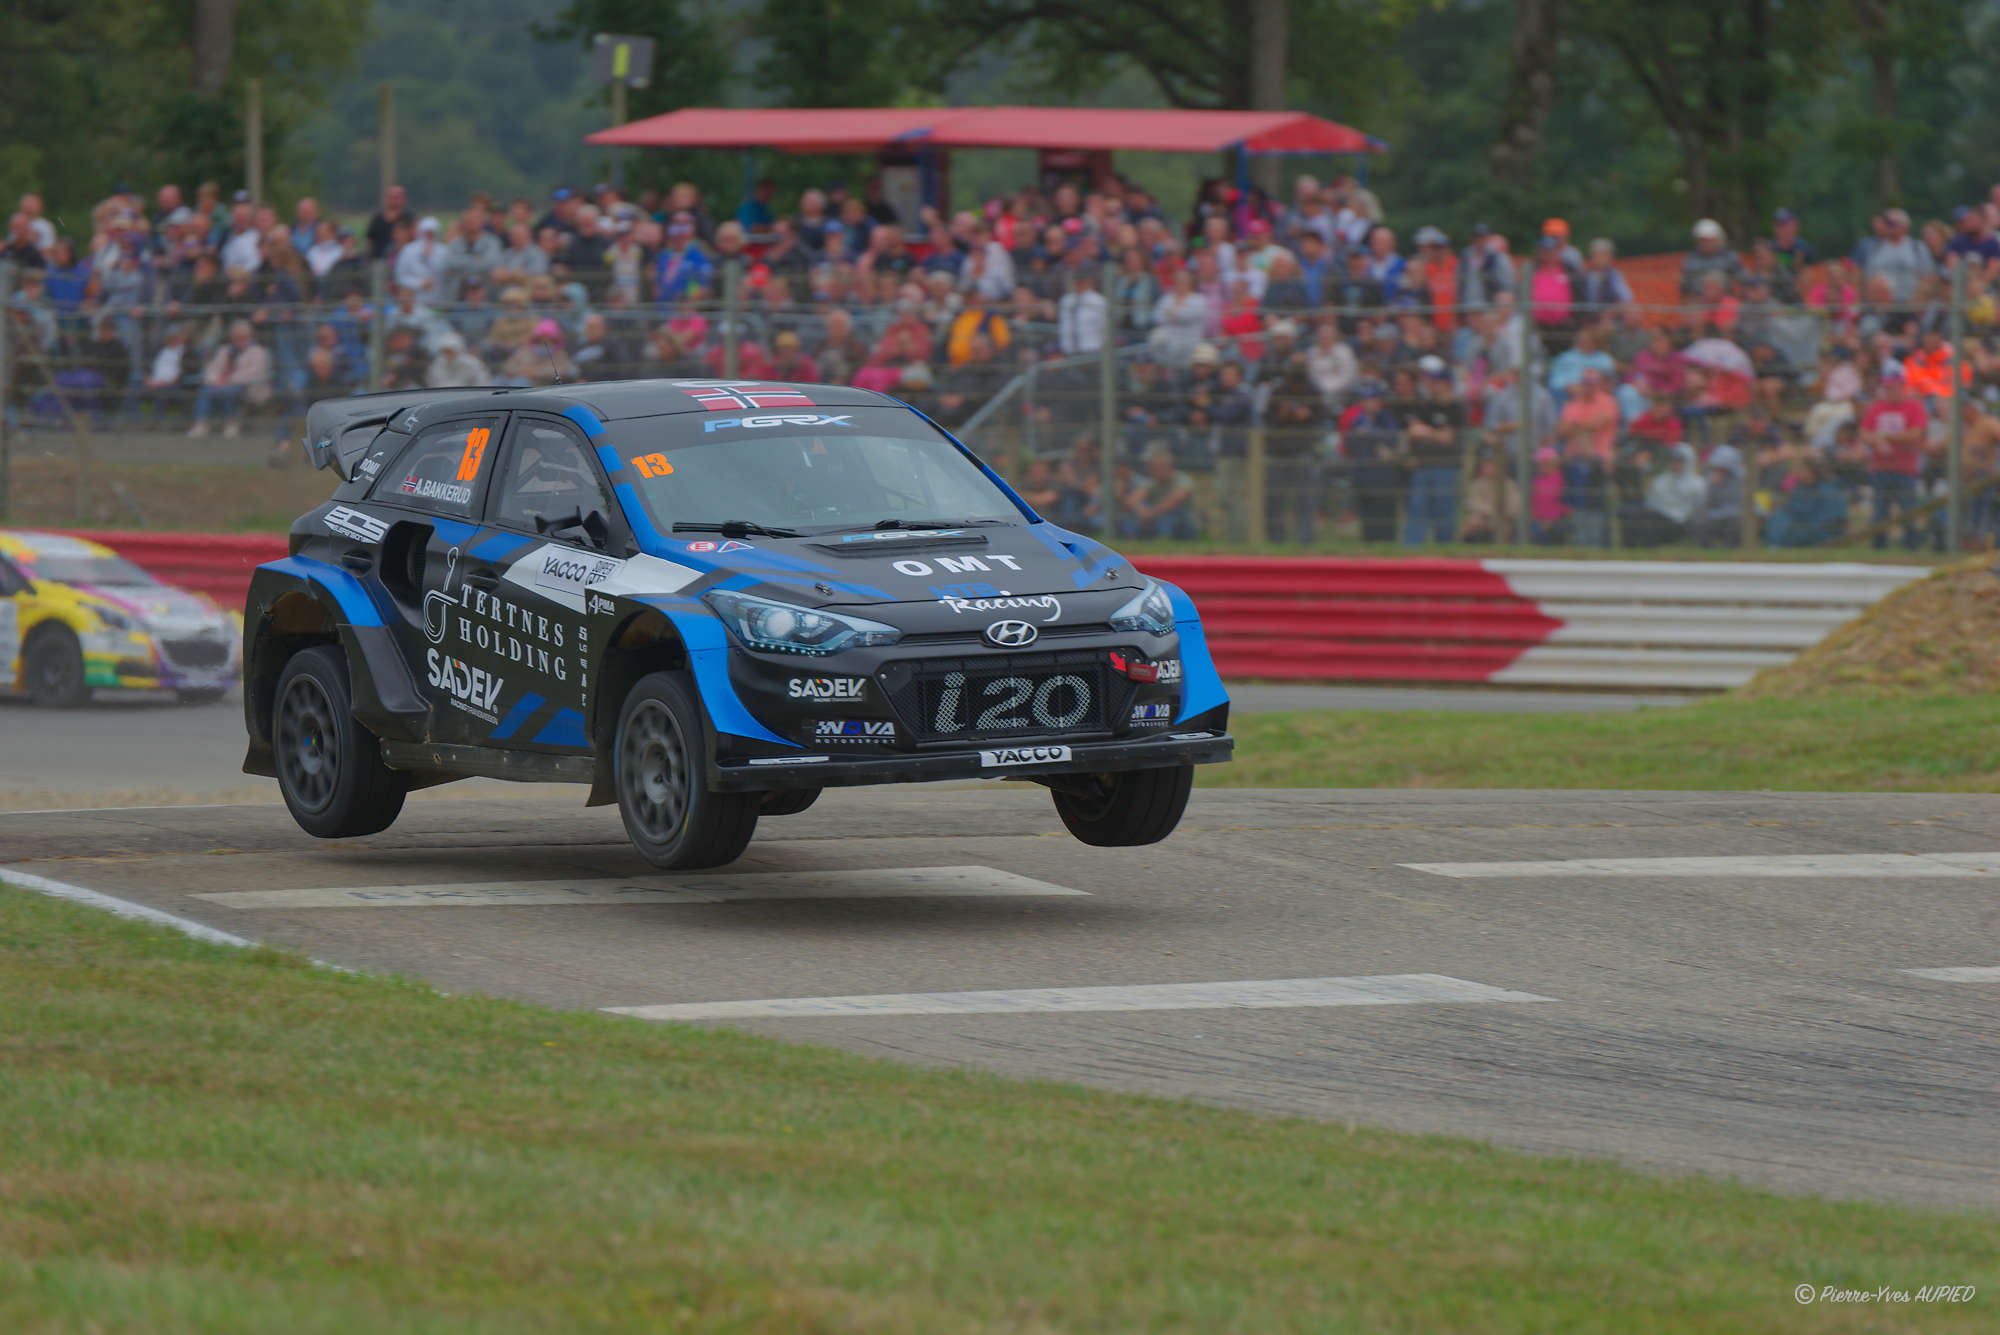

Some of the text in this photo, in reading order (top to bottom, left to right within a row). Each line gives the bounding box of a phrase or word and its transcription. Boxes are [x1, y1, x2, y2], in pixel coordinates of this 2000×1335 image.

[704, 415, 853, 432] PGRX
[457, 428, 490, 481] 13
[631, 453, 674, 480] 13
[415, 478, 471, 504] A.BAKKERUD
[543, 556, 587, 582] YACCO
[892, 554, 1022, 577] OMT
[461, 583, 564, 648] TERTNES
[938, 590, 1062, 622] Racing
[458, 617, 566, 681] HOLDING
[427, 648, 503, 711] SADEV
[789, 678, 866, 698] SADEV
[935, 671, 1091, 733] i20
[817, 720, 895, 735] NOVA
[990, 747, 1063, 764] YACCO
